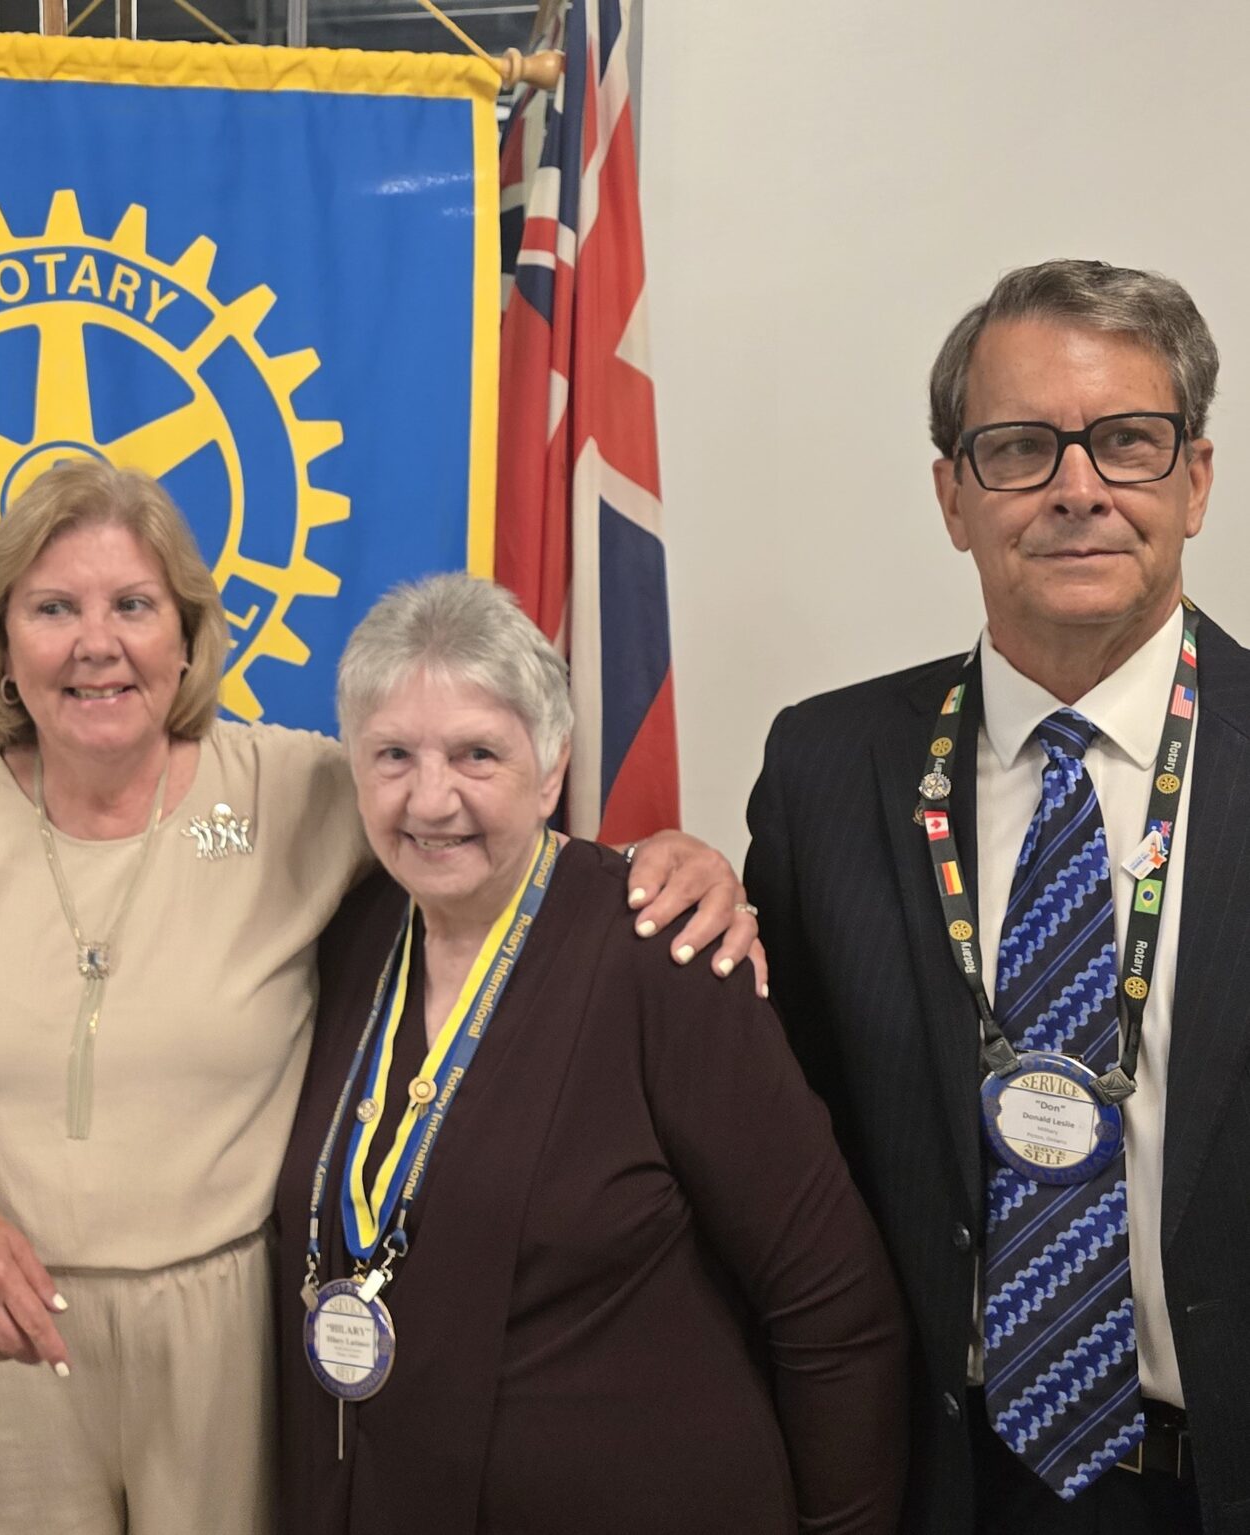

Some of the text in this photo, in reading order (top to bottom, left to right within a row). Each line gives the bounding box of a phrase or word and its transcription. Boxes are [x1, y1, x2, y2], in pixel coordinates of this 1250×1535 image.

[1163, 740, 1182, 773] Rotary
[960, 941, 977, 974] Rotary
[1130, 940, 1149, 976] Rotary
[467, 913, 533, 1039] Rotary International
[1020, 1074, 1080, 1098] SERVICE
[402, 1066, 465, 1200] Rotary International
[1022, 1111, 1075, 1128] Donald Leslie
[1022, 1148, 1067, 1165] SELF
